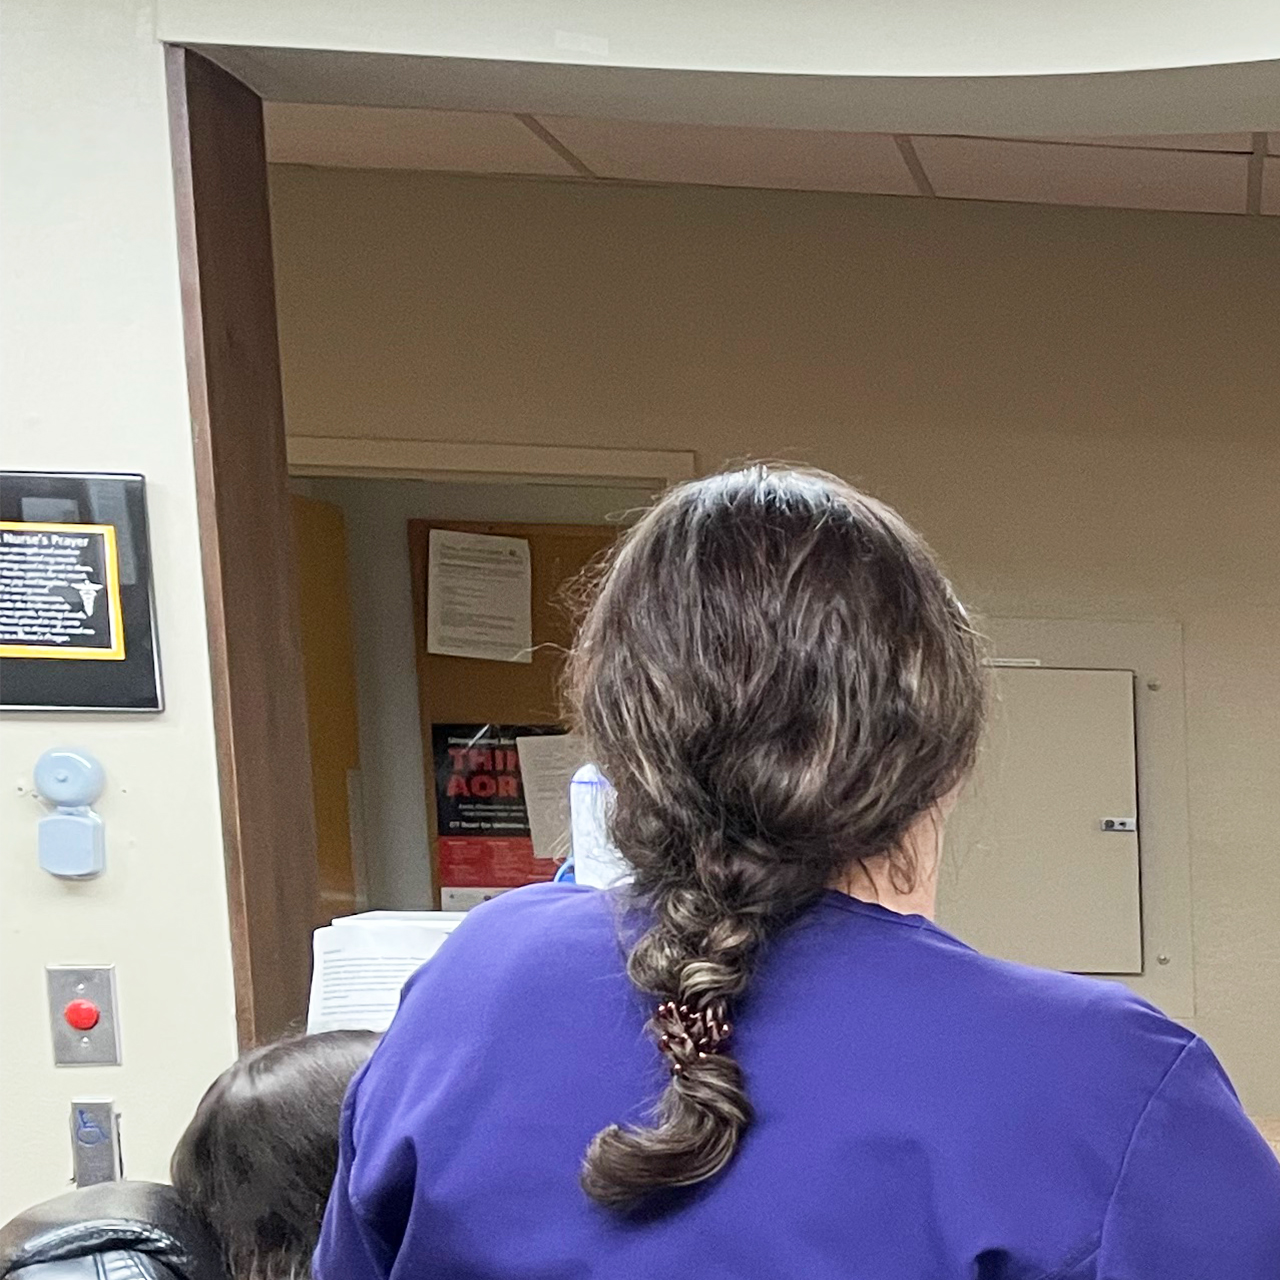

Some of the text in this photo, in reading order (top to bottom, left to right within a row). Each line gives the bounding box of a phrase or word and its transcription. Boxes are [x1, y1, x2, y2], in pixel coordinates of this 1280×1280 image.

[3, 533, 88, 547] Nurse's Prayer
[446, 775, 518, 797] AOR
